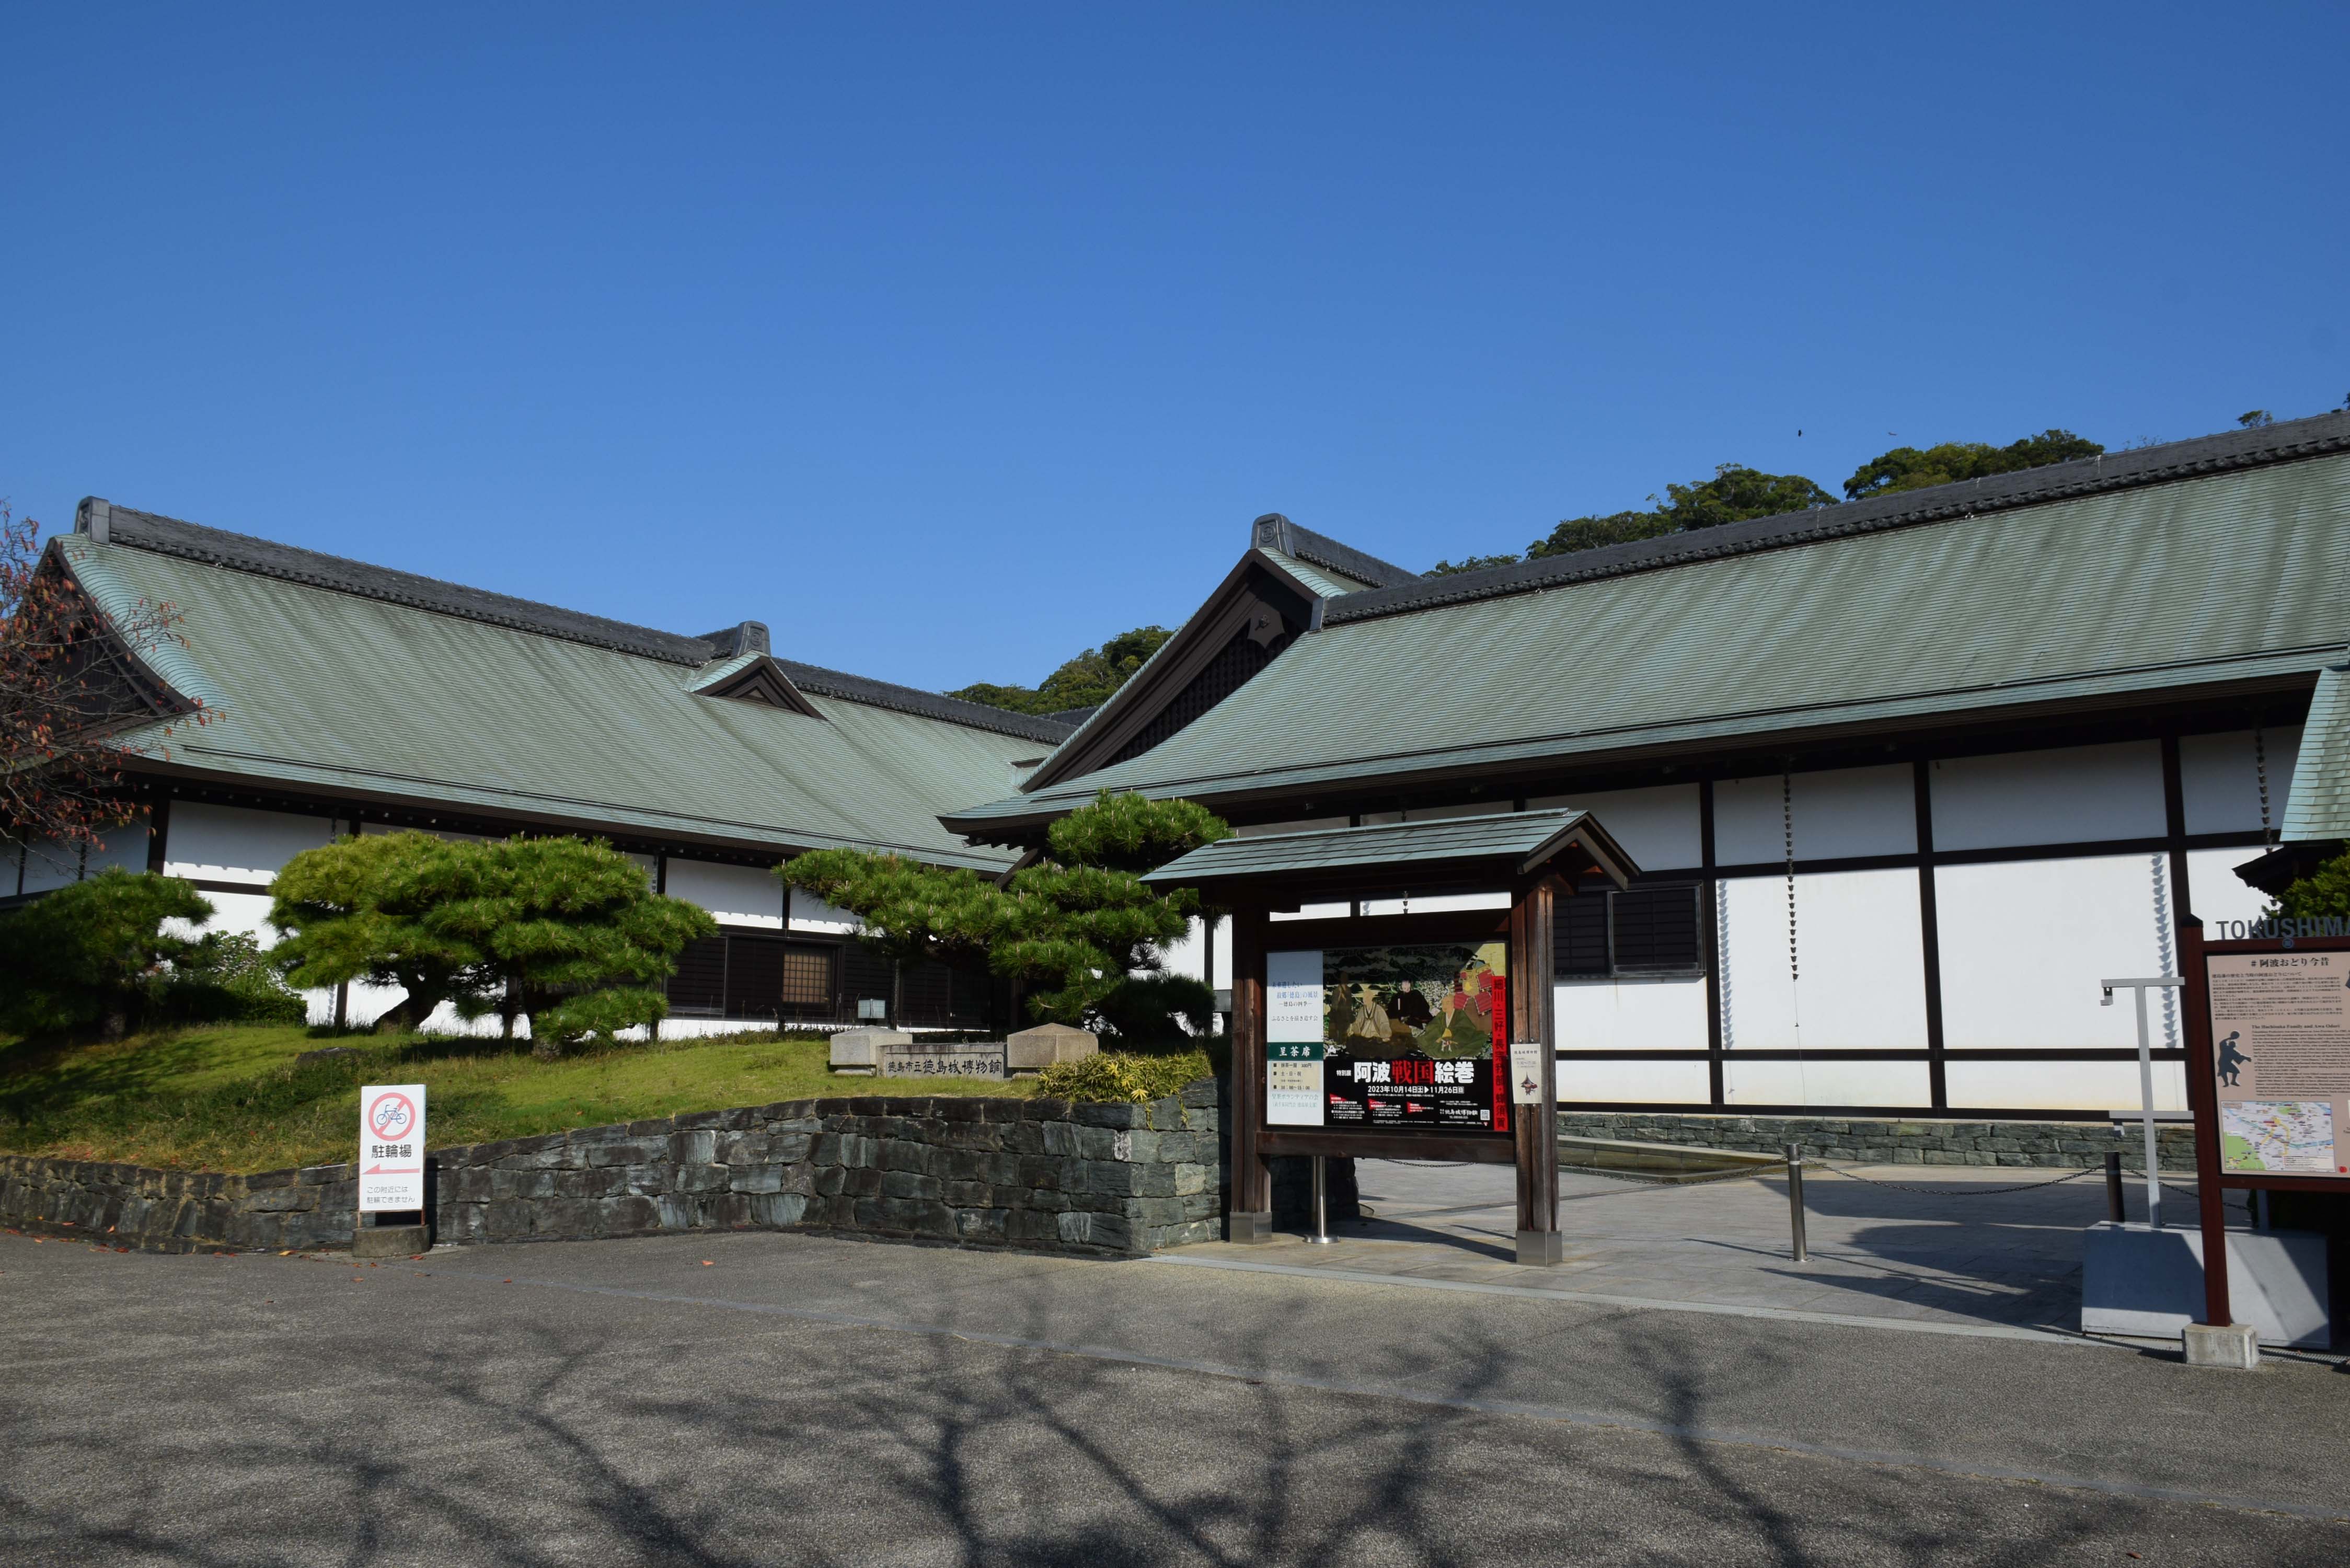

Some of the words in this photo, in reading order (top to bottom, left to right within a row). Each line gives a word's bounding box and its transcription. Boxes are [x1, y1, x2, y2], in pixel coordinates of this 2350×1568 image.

[2216, 916, 2350, 940] TOKUSHIM
[1279, 1045, 1311, 1057] 呈茶席
[1354, 1060, 1474, 1085] 阿波戦国絵巻
[372, 1145, 412, 1158] 駐輪場
